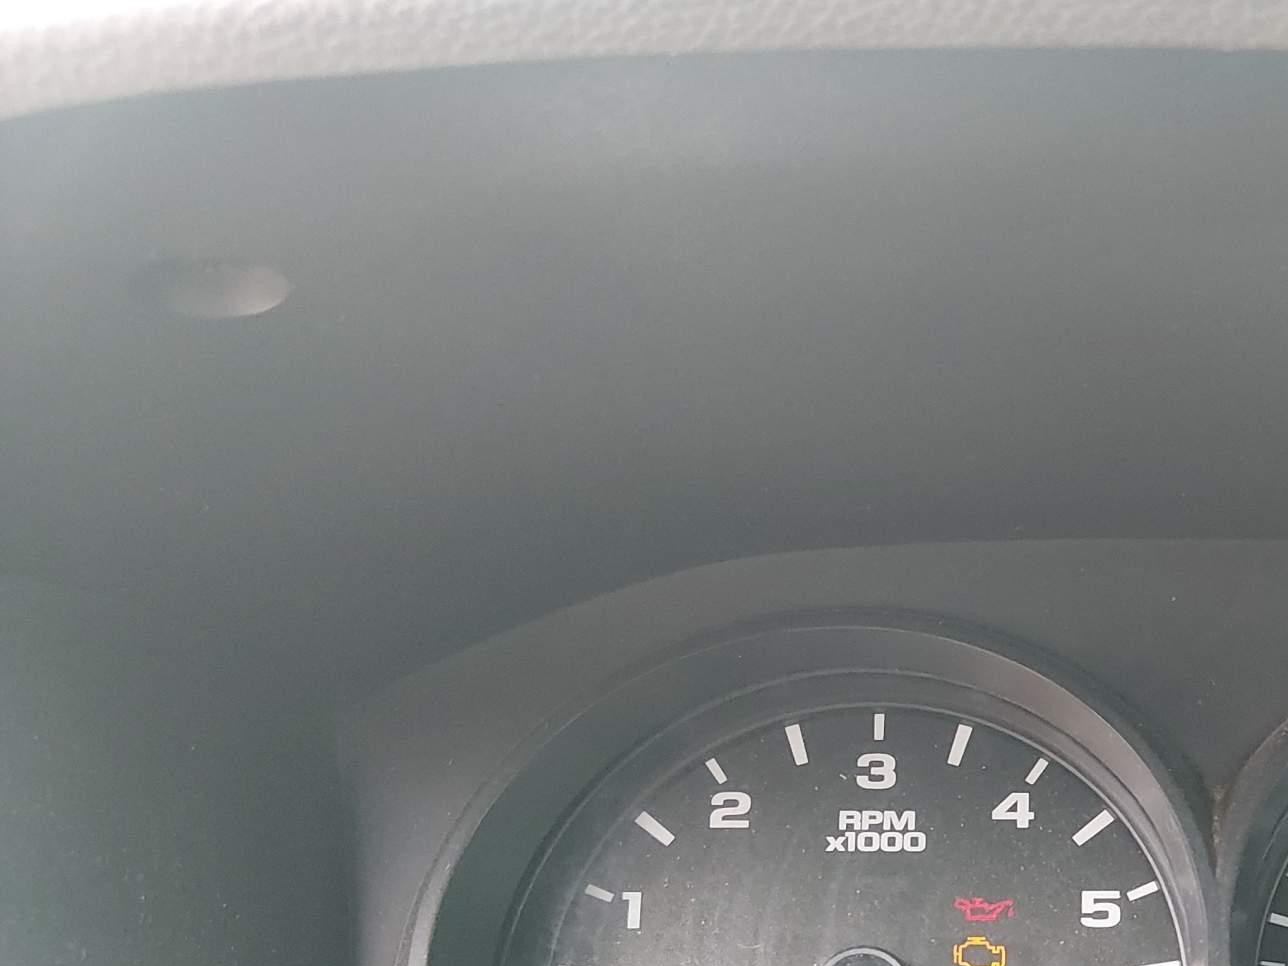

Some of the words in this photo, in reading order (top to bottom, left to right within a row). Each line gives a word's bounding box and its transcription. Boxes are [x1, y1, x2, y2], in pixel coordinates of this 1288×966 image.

[856, 753, 897, 790] 3
[709, 791, 752, 828] 2
[839, 810, 916, 831] RPM
[991, 792, 1035, 829] 4
[825, 831, 927, 852] x1000
[622, 891, 642, 929] 1
[1080, 890, 1121, 928] 5
